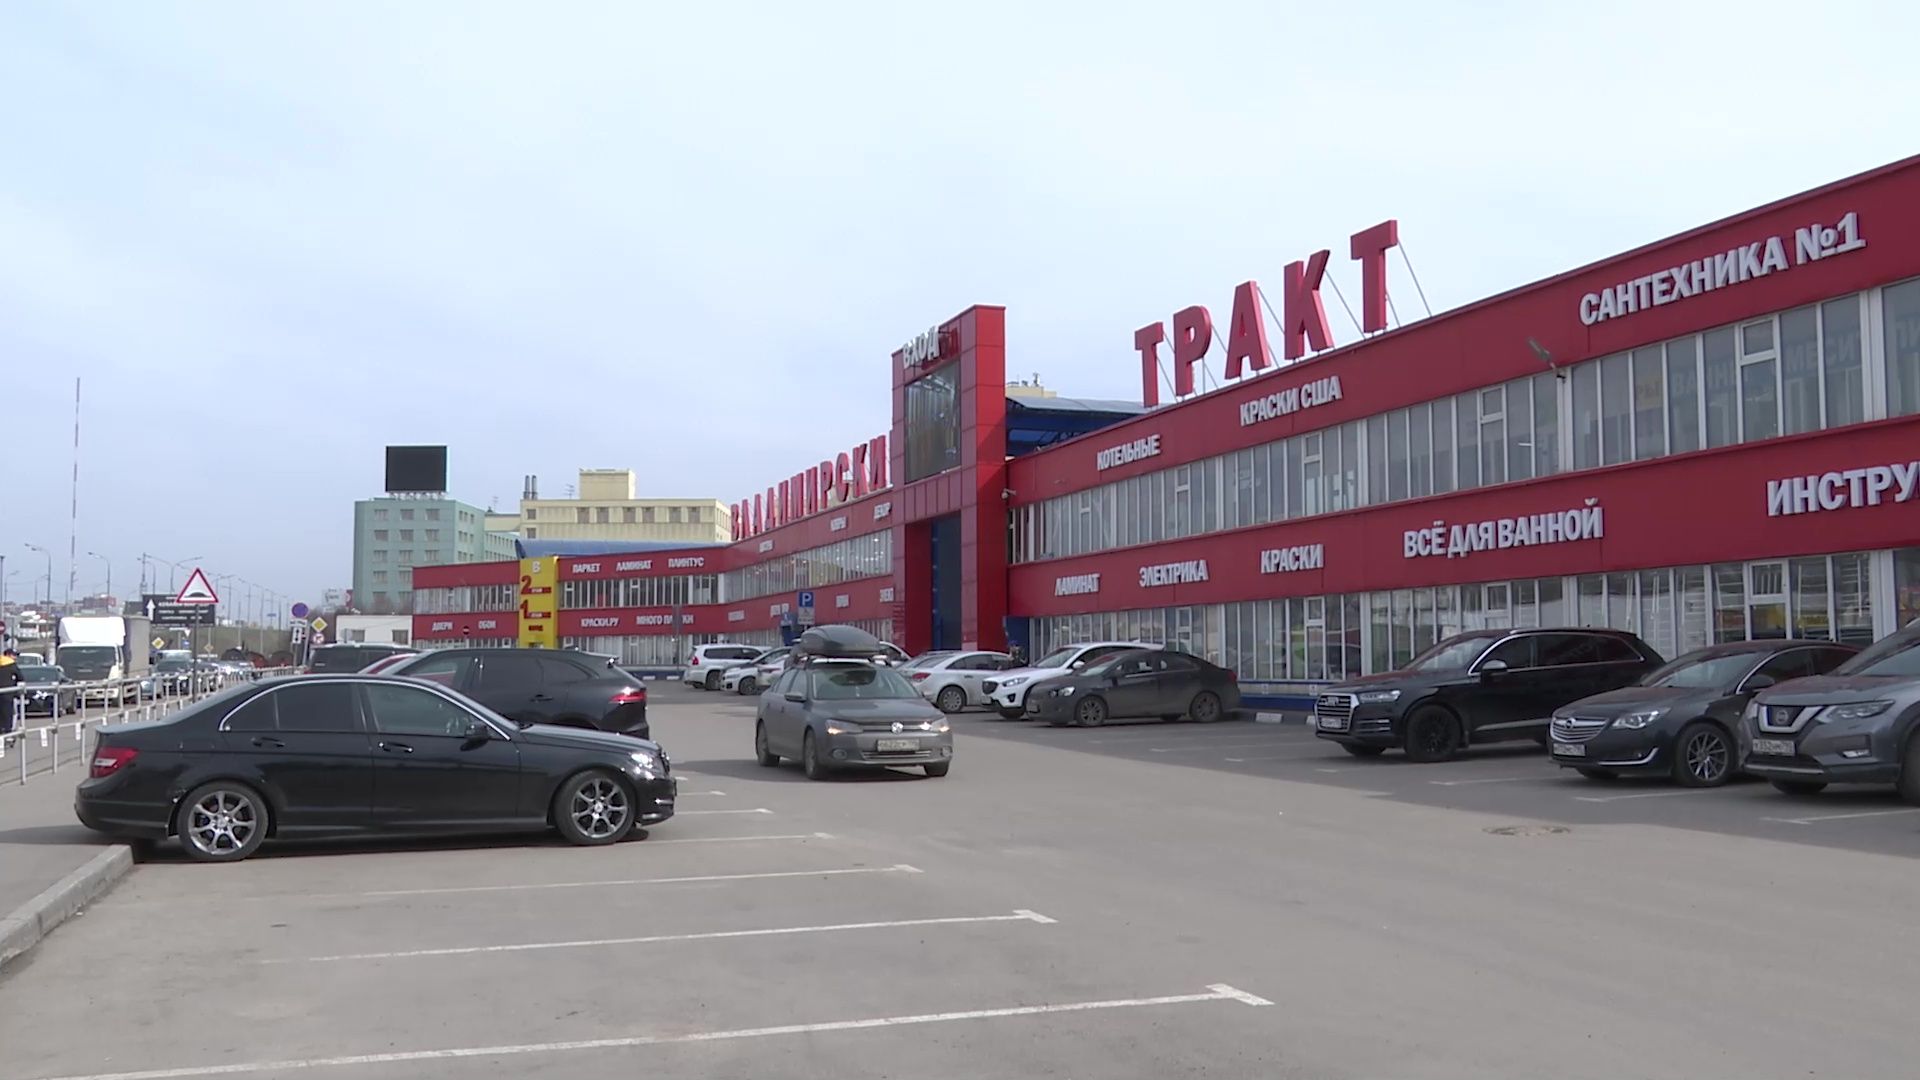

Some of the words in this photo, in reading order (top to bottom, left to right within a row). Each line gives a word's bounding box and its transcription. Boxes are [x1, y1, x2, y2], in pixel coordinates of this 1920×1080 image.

[1580, 236, 1789, 326] САНТЕХНИКА
[1795, 212, 1867, 265] №1
[1134, 220, 1397, 408] ТРАКТ
[903, 325, 940, 369] ВХОД
[1240, 387, 1300, 427] КРАСКИ
[1301, 375, 1343, 408] США
[1097, 434, 1161, 471] КОТЕЛЬНЫЕ
[1767, 461, 1920, 517] ИНСТРУ
[1404, 520, 1447, 558] ВСЁ
[1448, 521, 1497, 558] ДЛЯ
[1498, 498, 1603, 549] ВАННОЙ
[572, 563, 600, 574] ПАРКЕТ
[616, 560, 652, 572] ЛАМИНАТ
[668, 557, 704, 568] ПЛИНТУС
[1139, 559, 1209, 588] ЭЛЕКТРИКА
[1260, 544, 1324, 574] КРАСКИ
[521, 575, 532, 594] 2
[1055, 573, 1100, 596] ЛАМИНАТ
[636, 615, 662, 625] МНОГО
